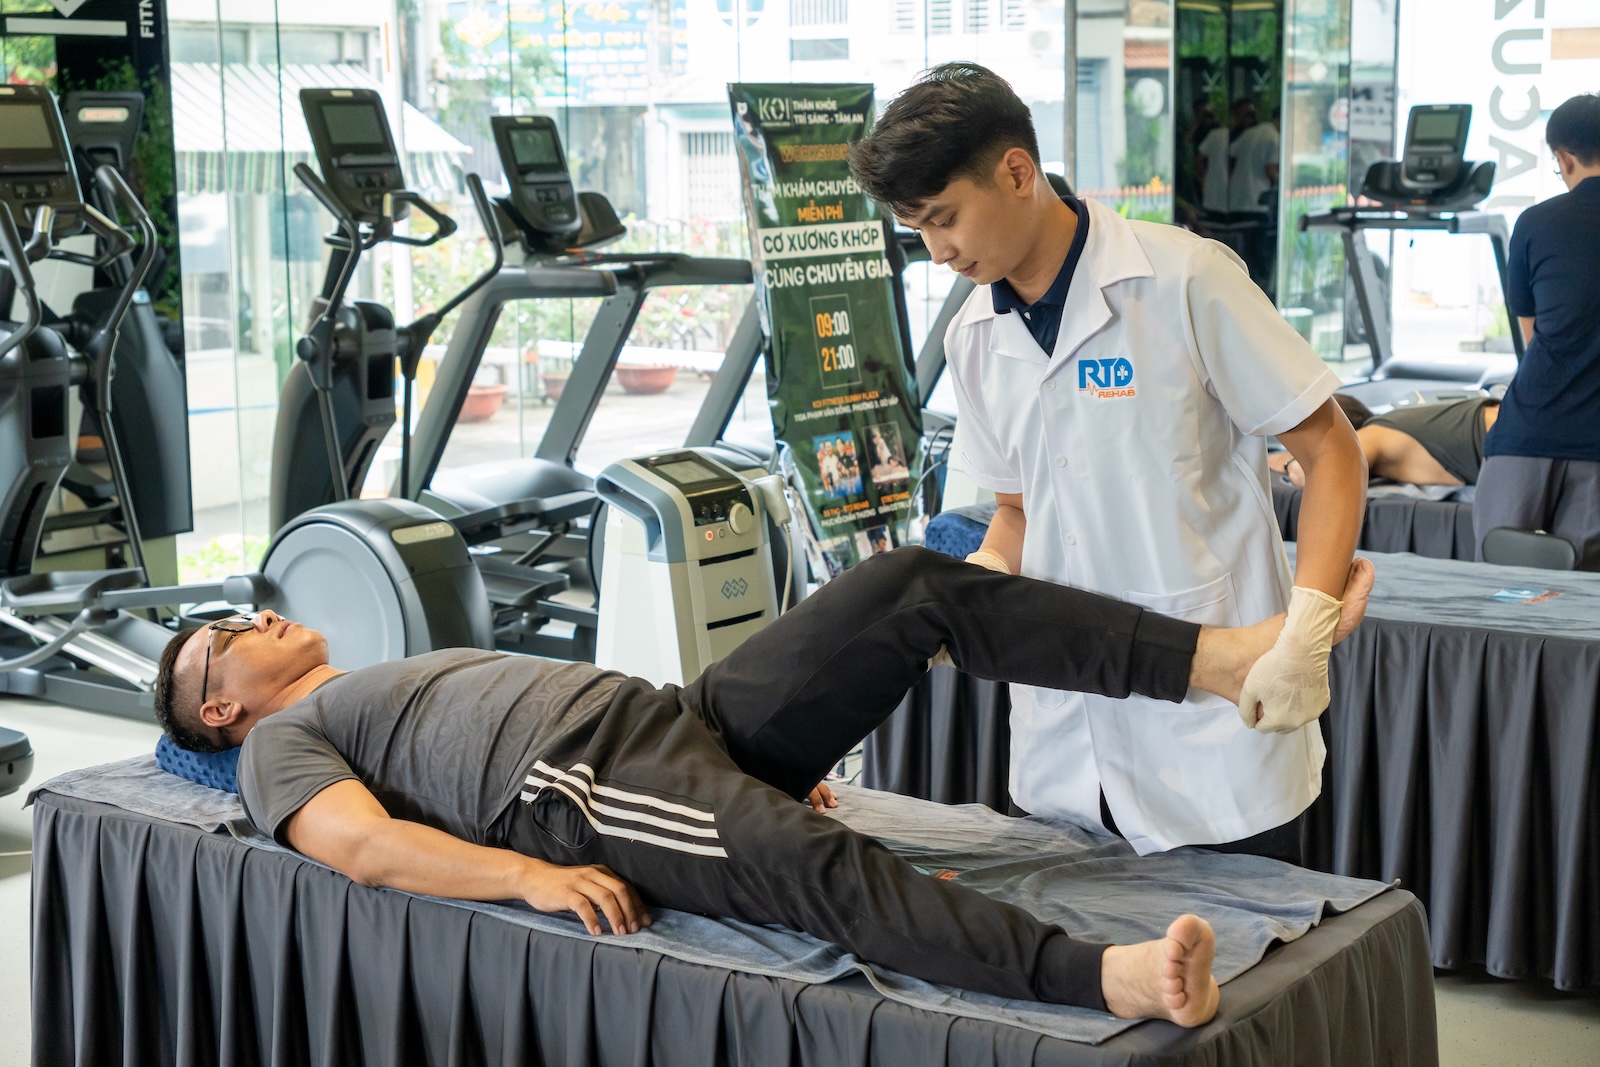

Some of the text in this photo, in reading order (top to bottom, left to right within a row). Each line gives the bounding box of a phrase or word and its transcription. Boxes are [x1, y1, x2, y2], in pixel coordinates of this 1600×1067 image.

[758, 97, 790, 120] KOI
[793, 112, 807, 125] TRÍ
[807, 111, 830, 124] SÁNG
[834, 111, 851, 123] TÂM
[852, 113, 864, 123] AN
[782, 177, 815, 198] KHÁM
[797, 199, 844, 222] MIỄN PHÍ
[762, 222, 880, 254] CƠ XƯƠNG KHỚP
[763, 257, 894, 289] CÙNG CHUYÊN GIA
[815, 310, 850, 338] 09:00
[821, 344, 856, 372] 21:00
[1098, 389, 1136, 399] REHAB
